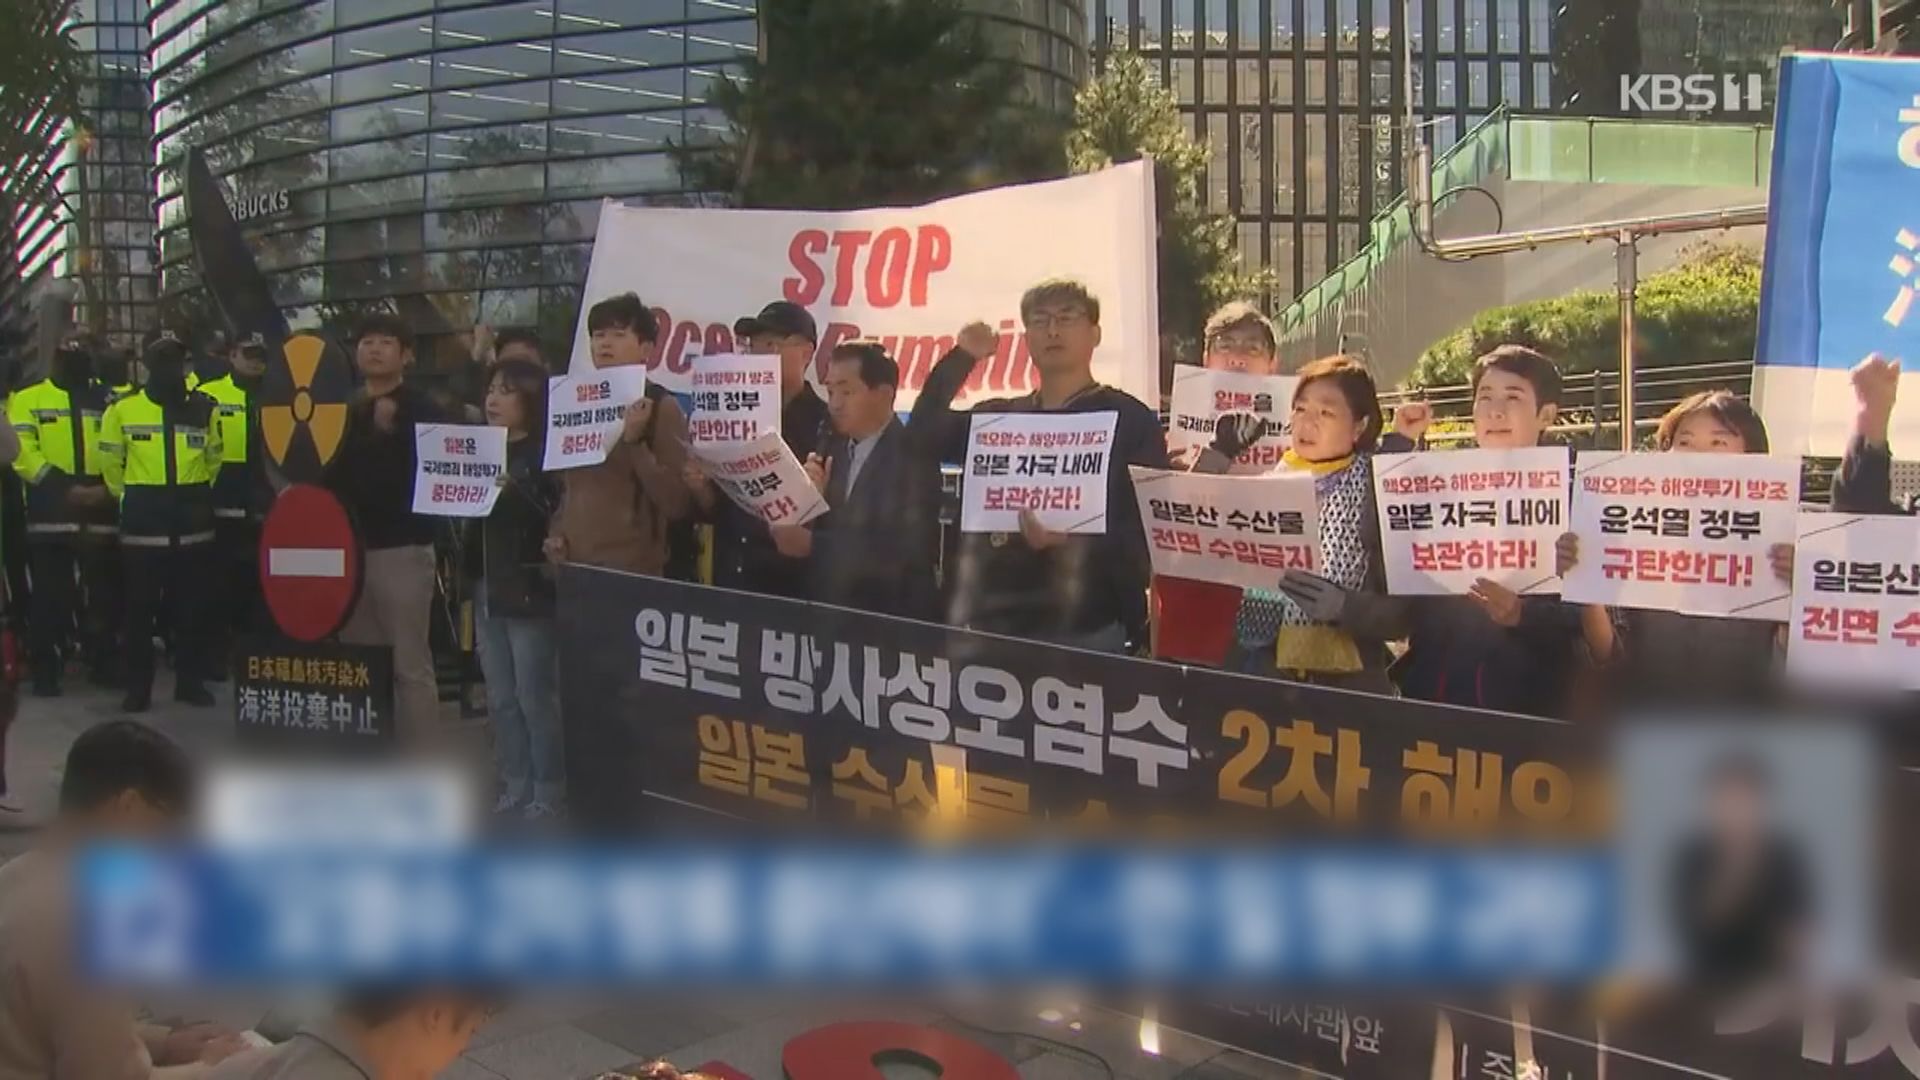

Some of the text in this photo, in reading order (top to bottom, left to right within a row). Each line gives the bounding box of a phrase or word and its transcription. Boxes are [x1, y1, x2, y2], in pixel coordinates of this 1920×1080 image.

[227, 187, 289, 222] RBUCKS
[782, 224, 953, 310] STOP
[576, 380, 611, 402] 일본은
[692, 390, 760, 411] 석열 정부
[594, 405, 626, 423] 해양투
[444, 436, 477, 455] 일본은
[562, 432, 603, 455] 중단하
[975, 431, 1027, 447] 핵오염수
[1028, 431, 1080, 448] 해양투기
[973, 452, 1103, 477] 일본 자국 내에
[432, 483, 489, 504] 중단하라!
[984, 486, 1081, 511] 보관하라!
[1383, 470, 1561, 495] 핵오염수 해양투기 말고
[1583, 476, 1790, 501] 핵오염수 해양투기 방조
[1149, 498, 1304, 535] 일본산 수산물
[1387, 499, 1561, 531] 일본 자국 내에
[1600, 505, 1762, 541] 윤석열 정부
[1151, 527, 1314, 570] 전면 수입금지
[1412, 539, 1538, 571] 보관하라!
[1602, 547, 1754, 587] 규탄한다!
[1813, 559, 1920, 595] 일본산
[1802, 606, 1879, 645] 전면
[239, 685, 379, 735] 海洋投棄中止
[635, 607, 741, 699] 일본
[760, 627, 1189, 788] 방사성오염수
[1218, 708, 1371, 824] 2차
[697, 713, 811, 810] 일본
